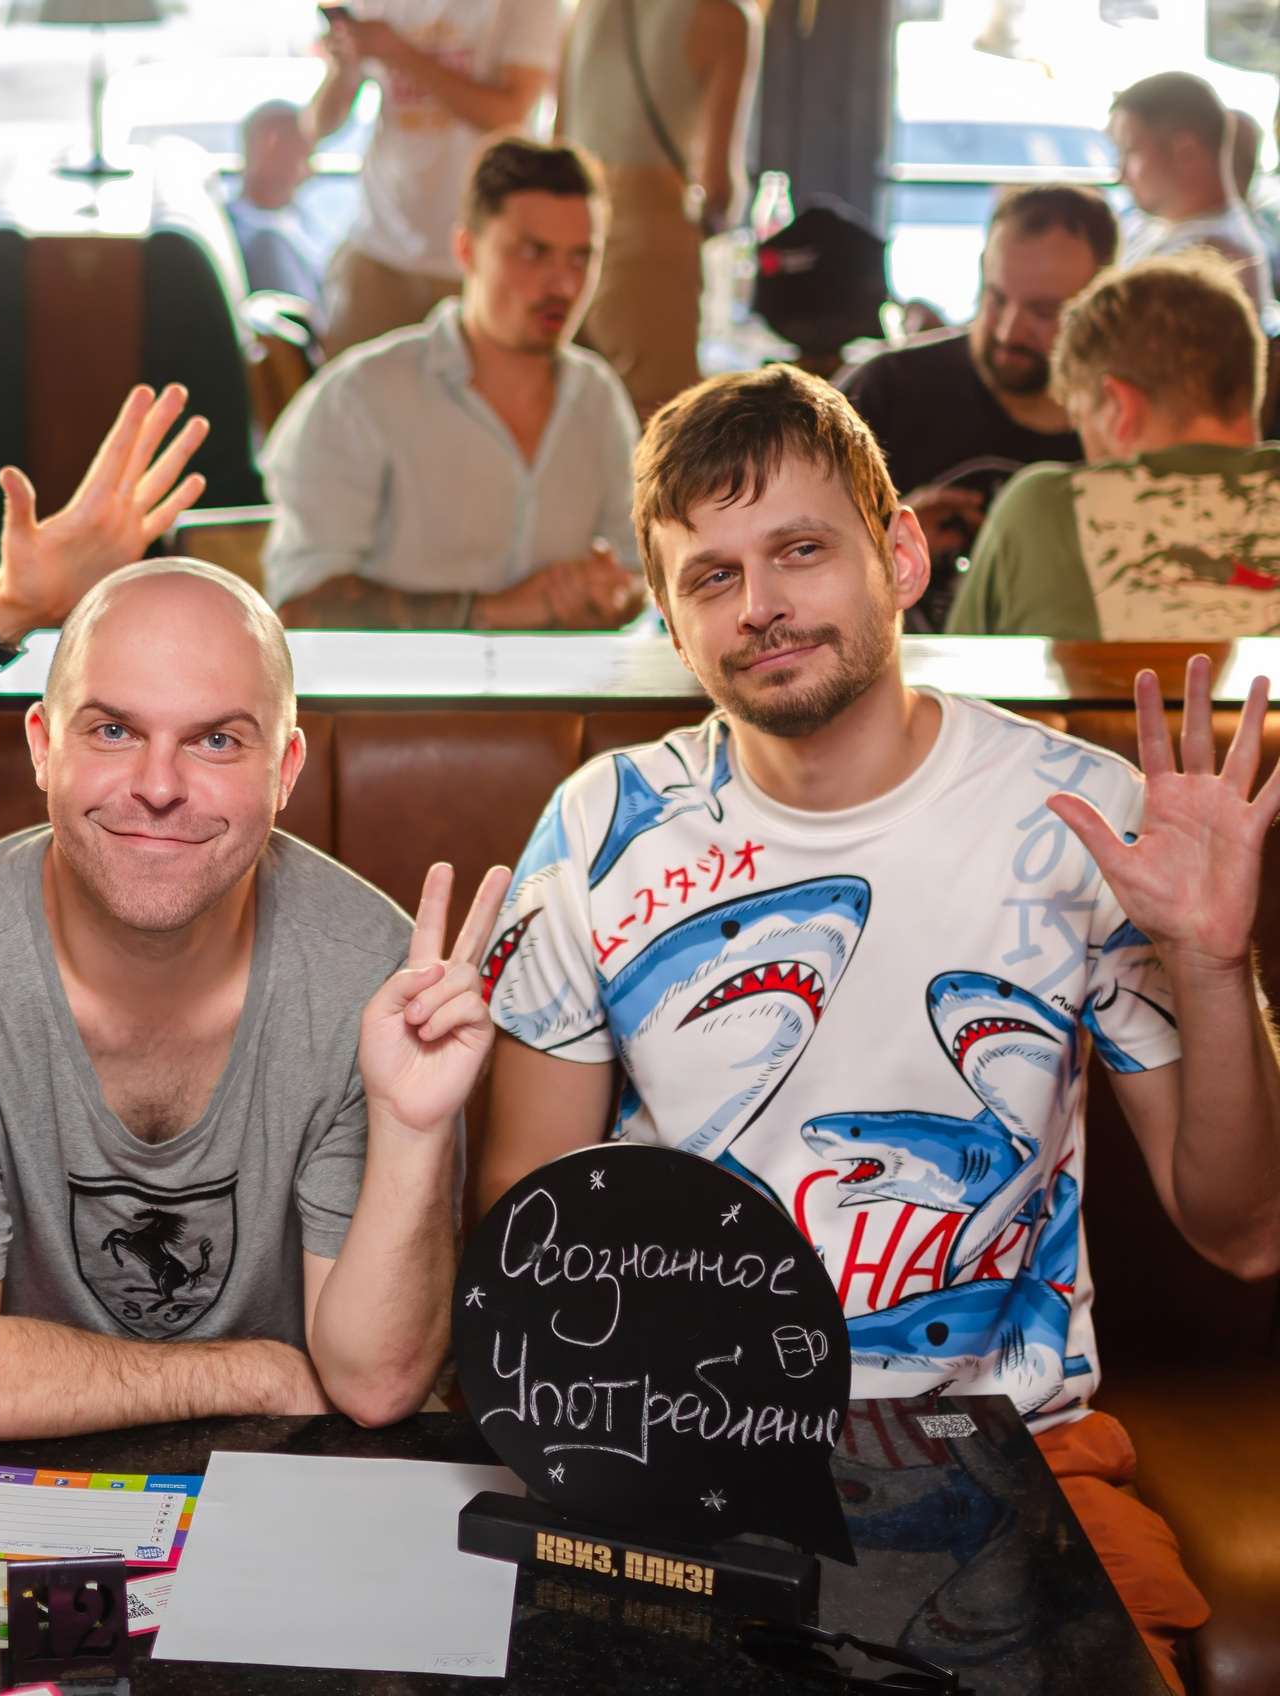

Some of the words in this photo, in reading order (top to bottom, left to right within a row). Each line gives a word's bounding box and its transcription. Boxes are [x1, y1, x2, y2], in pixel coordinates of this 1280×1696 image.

[501, 1188, 799, 1348] Осознанное
[481, 1330, 839, 1465] Употребление
[536, 1532, 618, 1578] КВИЗ,
[624, 1550, 715, 1596] ПЛИЗ!
